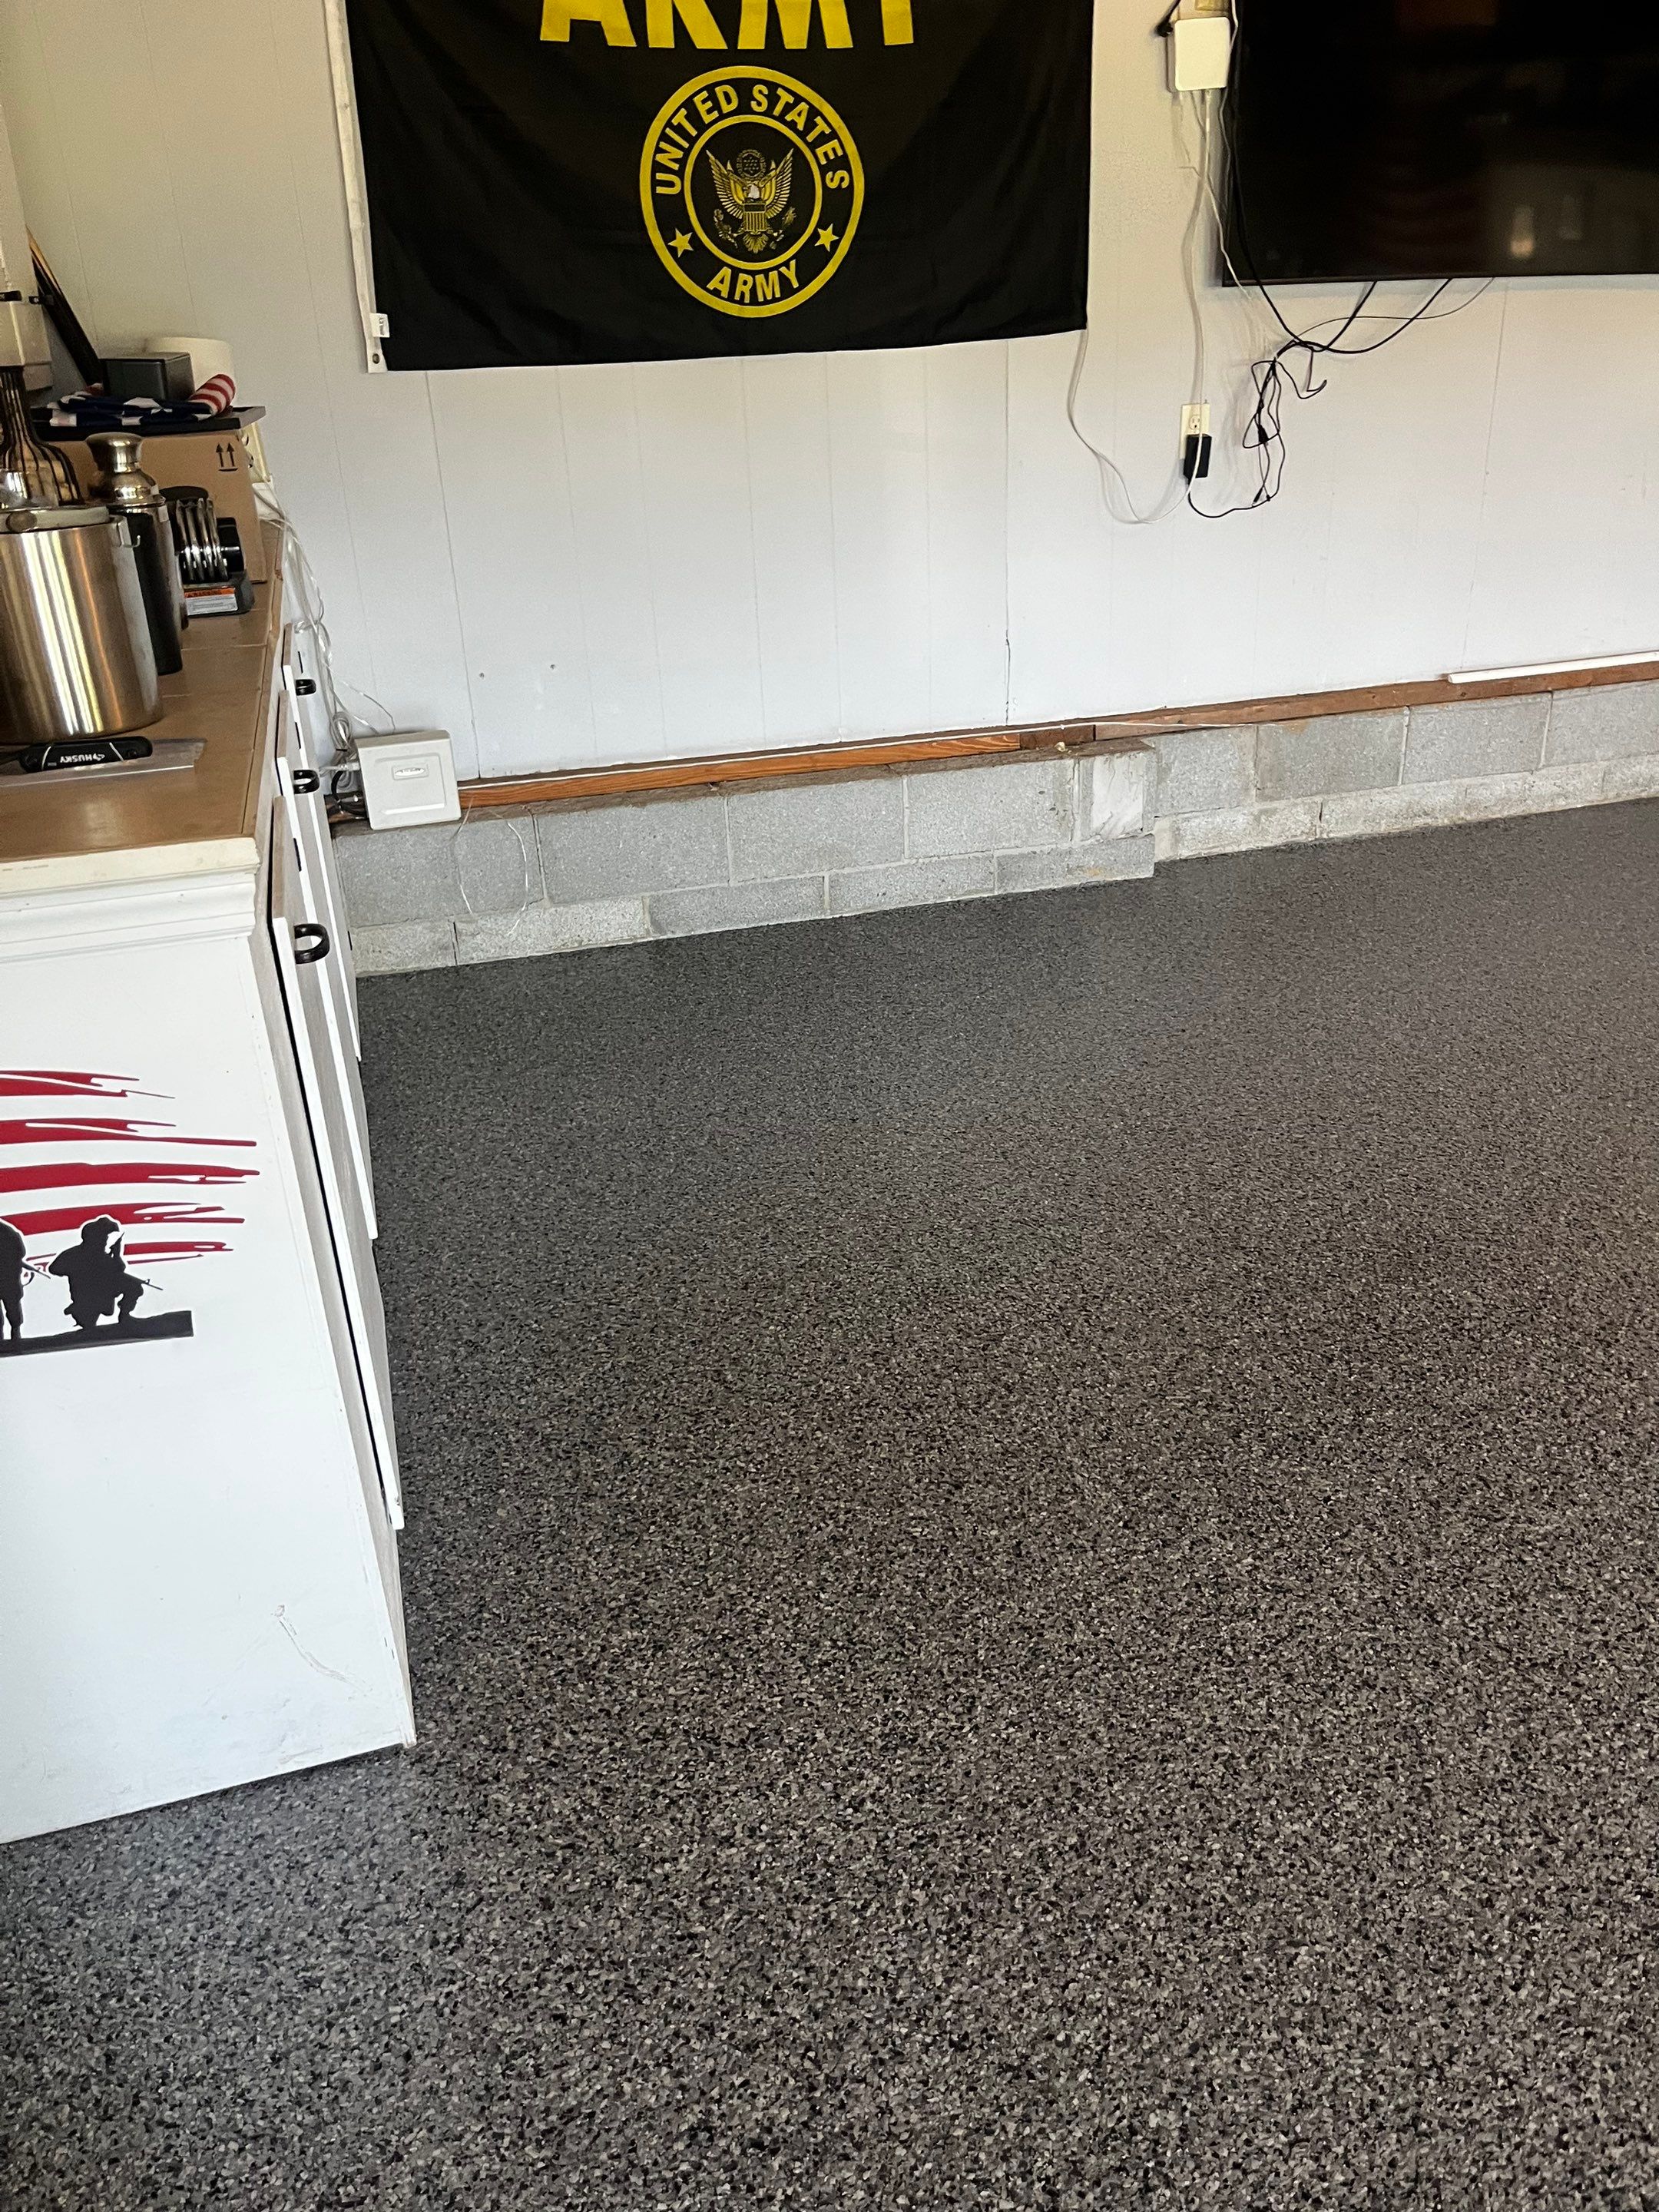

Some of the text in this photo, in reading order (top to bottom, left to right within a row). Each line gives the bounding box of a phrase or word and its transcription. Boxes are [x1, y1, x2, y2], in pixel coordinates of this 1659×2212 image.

[655, 84, 850, 195] UNITED STATES
[707, 259, 799, 303] ARMY
[60, 753, 92, 763] HUSKY
